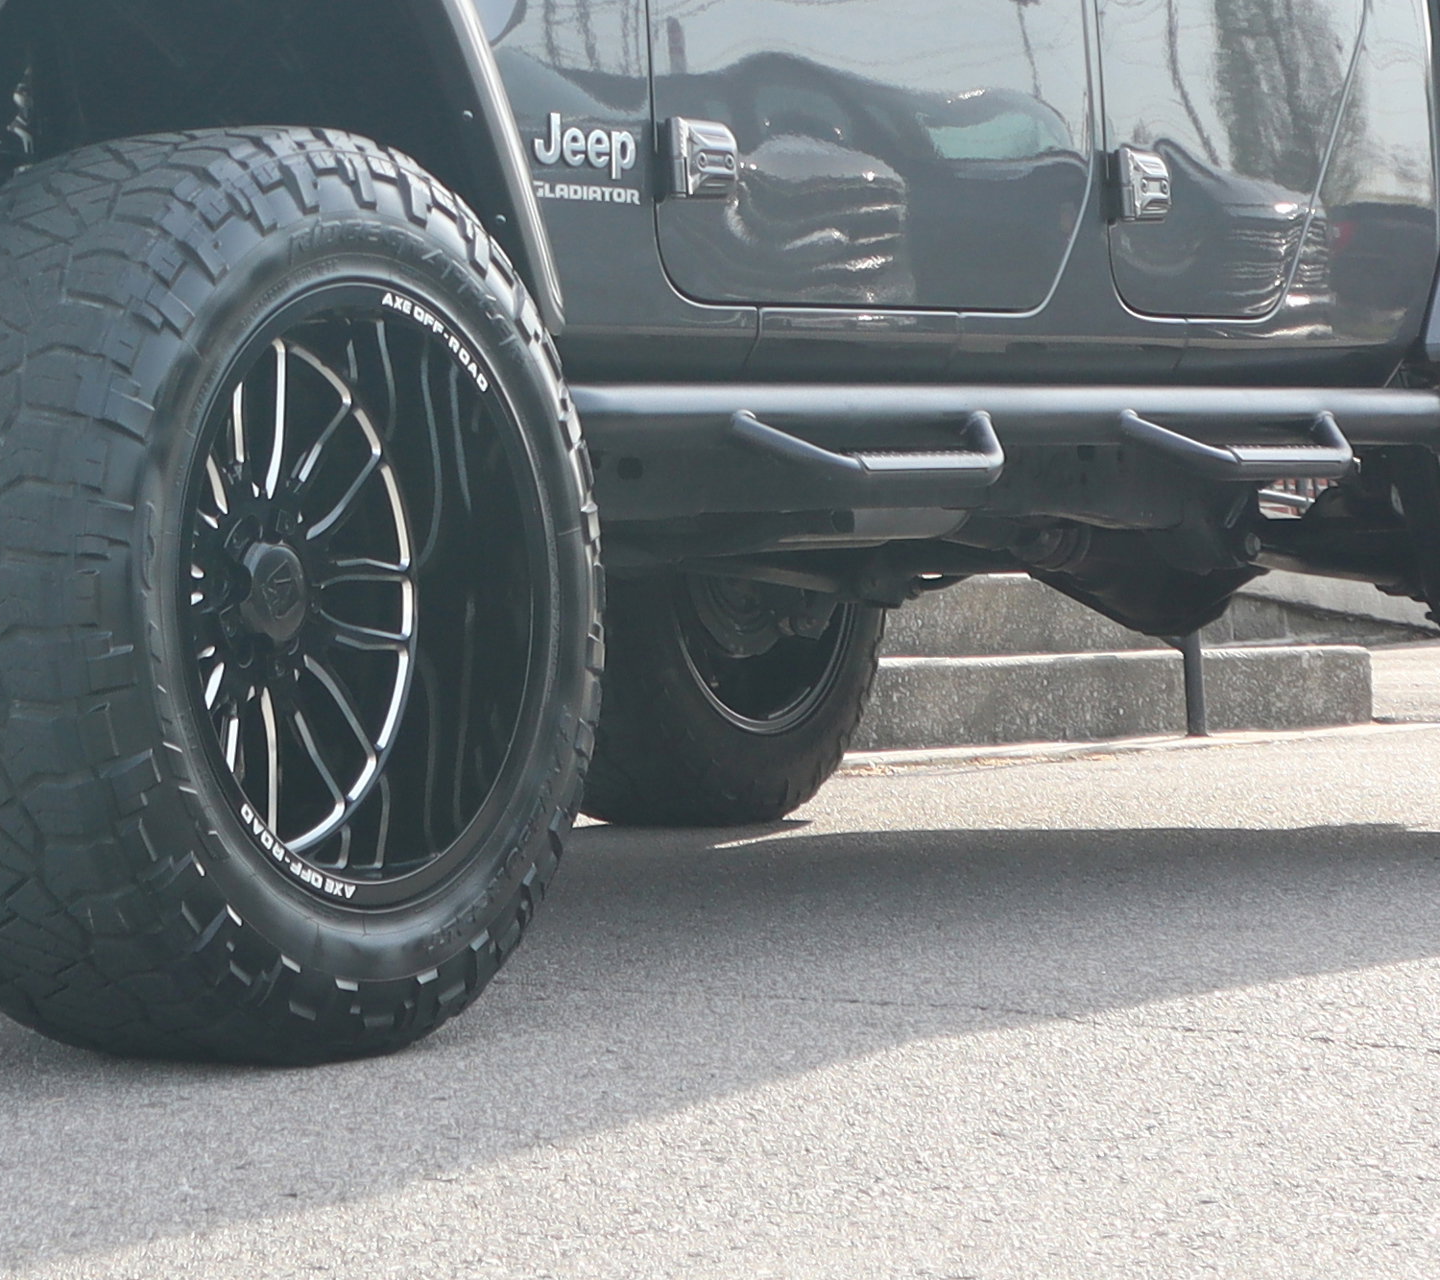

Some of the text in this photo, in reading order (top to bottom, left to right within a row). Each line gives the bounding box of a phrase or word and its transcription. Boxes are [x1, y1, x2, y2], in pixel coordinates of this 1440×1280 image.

[533, 111, 637, 180] Jeep
[381, 292, 413, 316] AXE
[412, 304, 489, 392] OFF-ROAD
[323, 877, 357, 899] AXE
